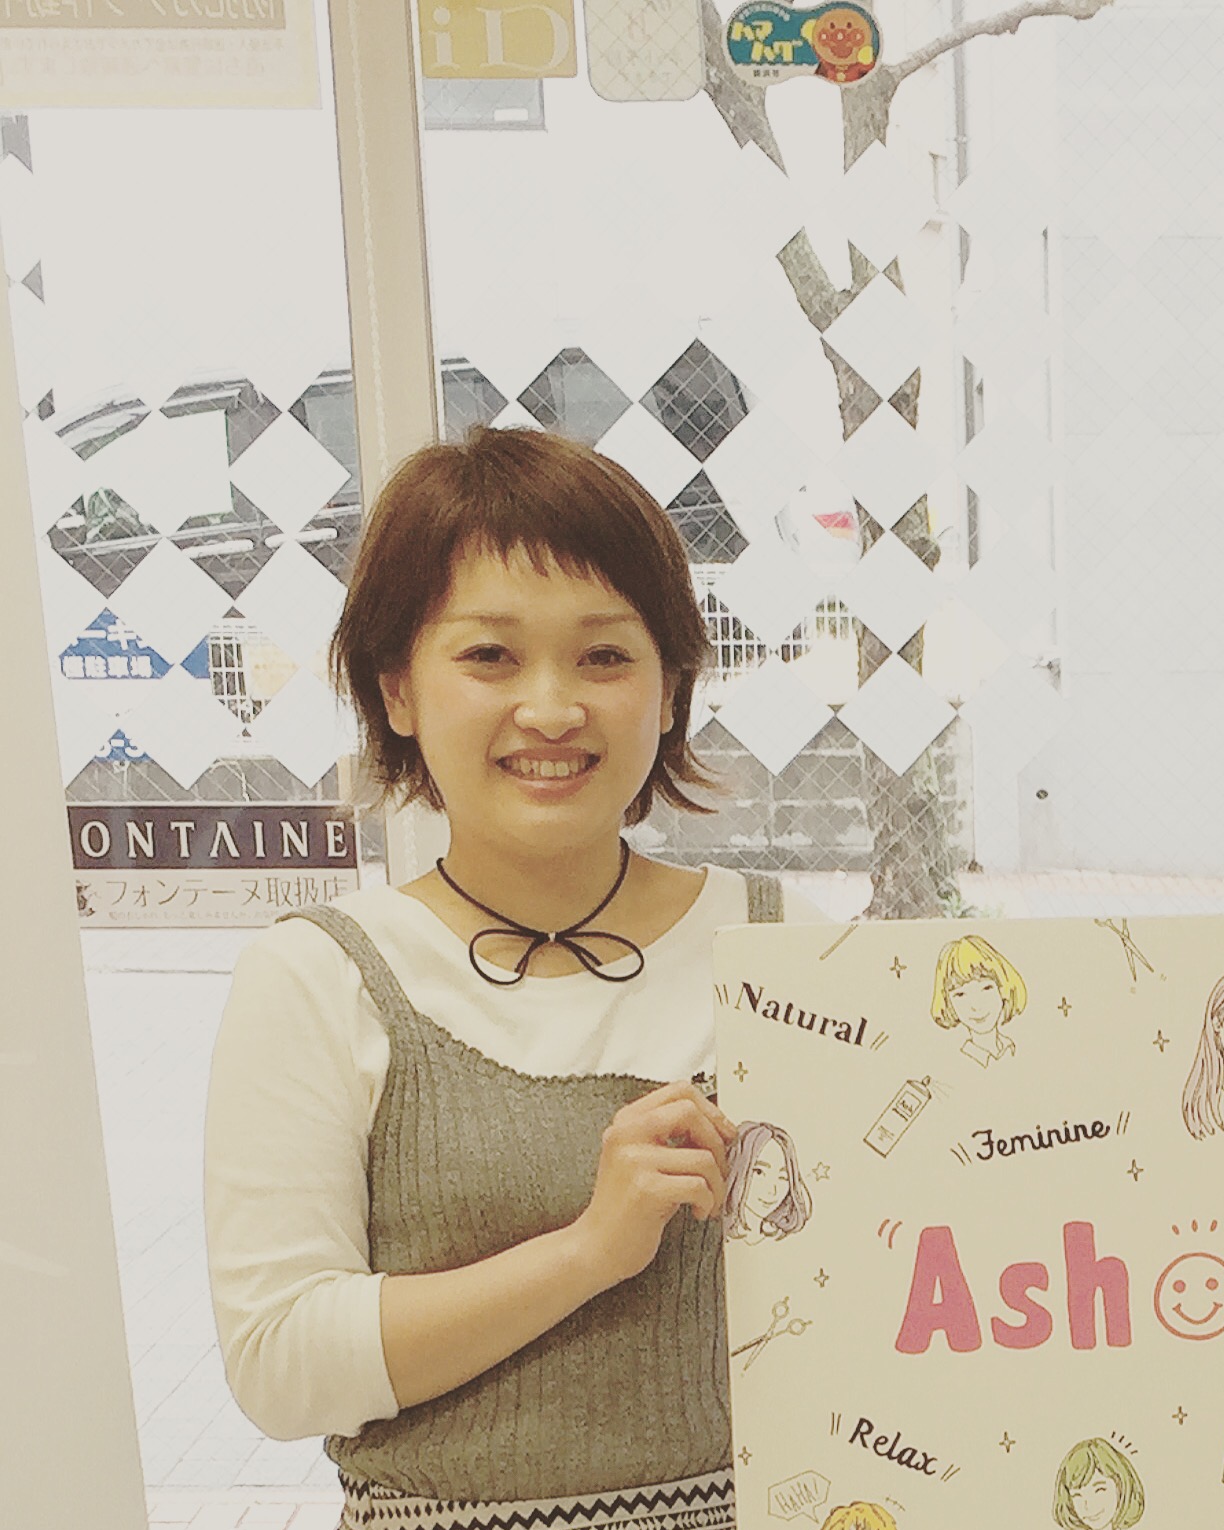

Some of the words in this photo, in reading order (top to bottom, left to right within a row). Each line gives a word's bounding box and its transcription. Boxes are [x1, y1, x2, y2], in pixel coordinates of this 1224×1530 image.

[735, 981, 868, 1047] Natural
[972, 1118, 1111, 1162] Feminine
[895, 1220, 1132, 1355] Ash
[849, 1418, 939, 1477] Relax
